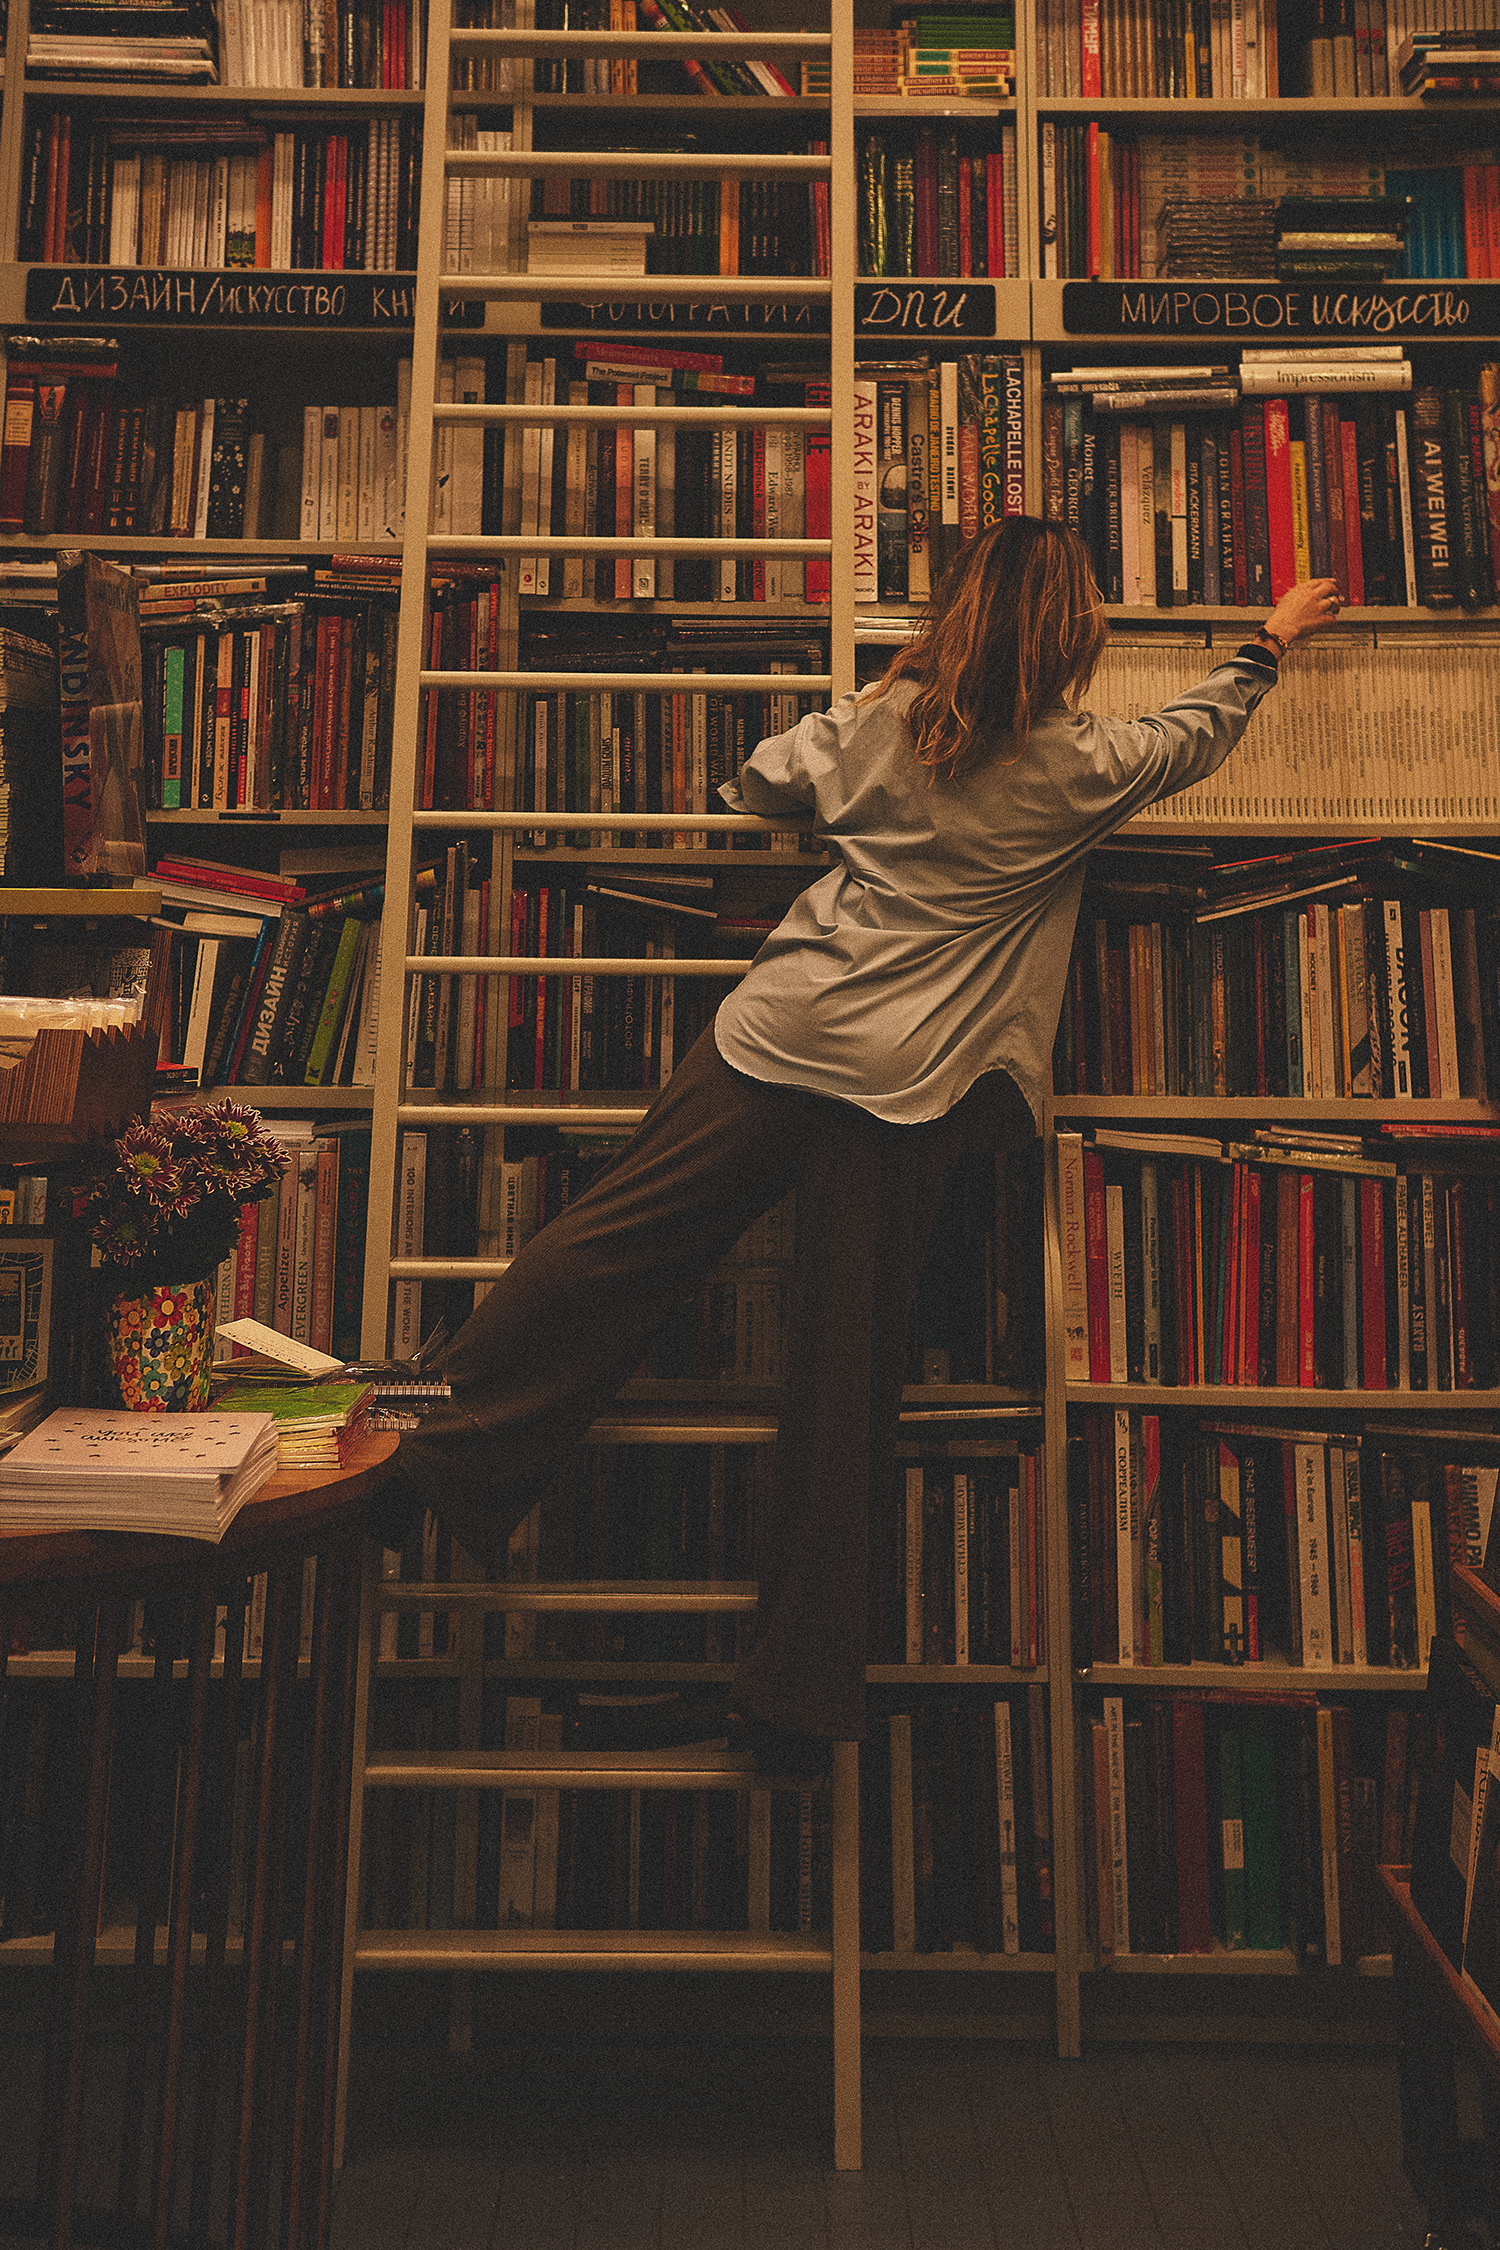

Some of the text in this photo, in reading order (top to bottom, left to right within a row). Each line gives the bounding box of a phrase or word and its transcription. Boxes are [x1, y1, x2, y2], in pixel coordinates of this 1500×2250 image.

[1084, 2, 1099, 54] ТИМУР
[373, 286, 468, 317] КНИ
[1121, 291, 1300, 328] МИРОВОЕ
[592, 366, 668, 385] The Polaroid Project
[1276, 369, 1377, 387] Impressionism
[891, 397, 902, 455] DENNIS HOPPER
[929, 390, 940, 512] MARIO DE JANEIRO TESTINO
[1006, 368, 1021, 515] LACHAPELLE LOST
[639, 457, 649, 488] TERRY
[854, 394, 873, 576] ARAKI BY ARAKI
[911, 434, 925, 503] Castro's
[1084, 433, 1095, 482] Monet
[724, 474, 734, 515] NUDES
[767, 472, 778, 514] Edward
[961, 474, 975, 540] WORLD
[983, 471, 1000, 530] Good
[1067, 467, 1079, 525] GEORGE
[1140, 465, 1152, 526] Velázquez
[1189, 462, 1200, 560] RITA ACKERMANN
[1219, 449, 1233, 569] JOHN GRAHAM
[1423, 441, 1449, 568] AI WEIWEI
[164, 582, 229, 598] EXPLODITY
[61, 621, 90, 811] ANDINSKY
[282, 920, 299, 967] ИСТОРИЯ
[430, 925, 439, 957] ОСНО
[250, 965, 287, 1056] ДИЗАЙН
[1064, 1156, 1081, 1292] Norman Rockwell
[1424, 1182, 1433, 1244] AI WEIWEI
[242, 1235, 252, 1272] Rooms
[261, 1245, 271, 1281] BATH
[277, 1246, 290, 1312] Appetizer
[401, 1167, 415, 1344] 100 INTERIORS THE WORLD
[1113, 1250, 1122, 1298] WYETH
[1399, 1225, 1407, 1289] ALTHAMER
[218, 1273, 230, 1342] NRTHERN
[295, 1261, 308, 1339] EVERGREEN
[1411, 1302, 1425, 1352] BANKSY
[1117, 1446, 1128, 1532] СЮРРЕАЛИЗМ
[1245, 1456, 1257, 1573] IS THAT BIEDERMEIER?
[1346, 1459, 1360, 1541] VISUAL IMPACT
[1462, 1474, 1481, 1541] MIMMO
[1147, 1518, 1158, 1562] POP ART
[1305, 1457, 1319, 1597] Art in Europe 1945 1968
[1385, 1516, 1410, 1557] Wild
